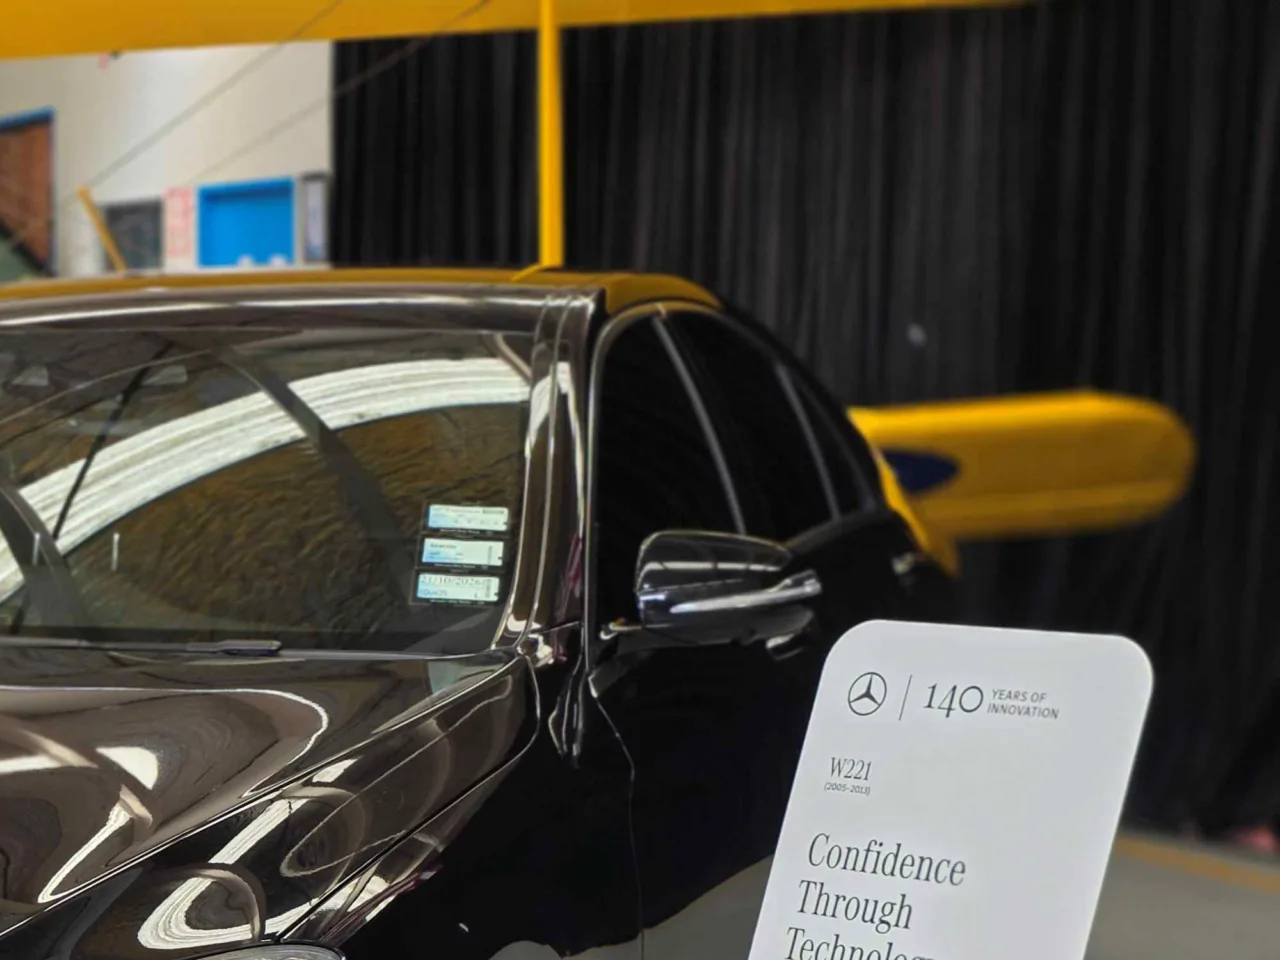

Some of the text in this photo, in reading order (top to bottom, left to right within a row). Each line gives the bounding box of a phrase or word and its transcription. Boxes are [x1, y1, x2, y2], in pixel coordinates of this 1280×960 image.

[923, 683, 1047, 719] 140 YEARS OF
[987, 703, 1059, 719] INNOVATION
[829, 757, 872, 781] W221
[808, 833, 966, 886] Confidence
[798, 880, 913, 934] Through
